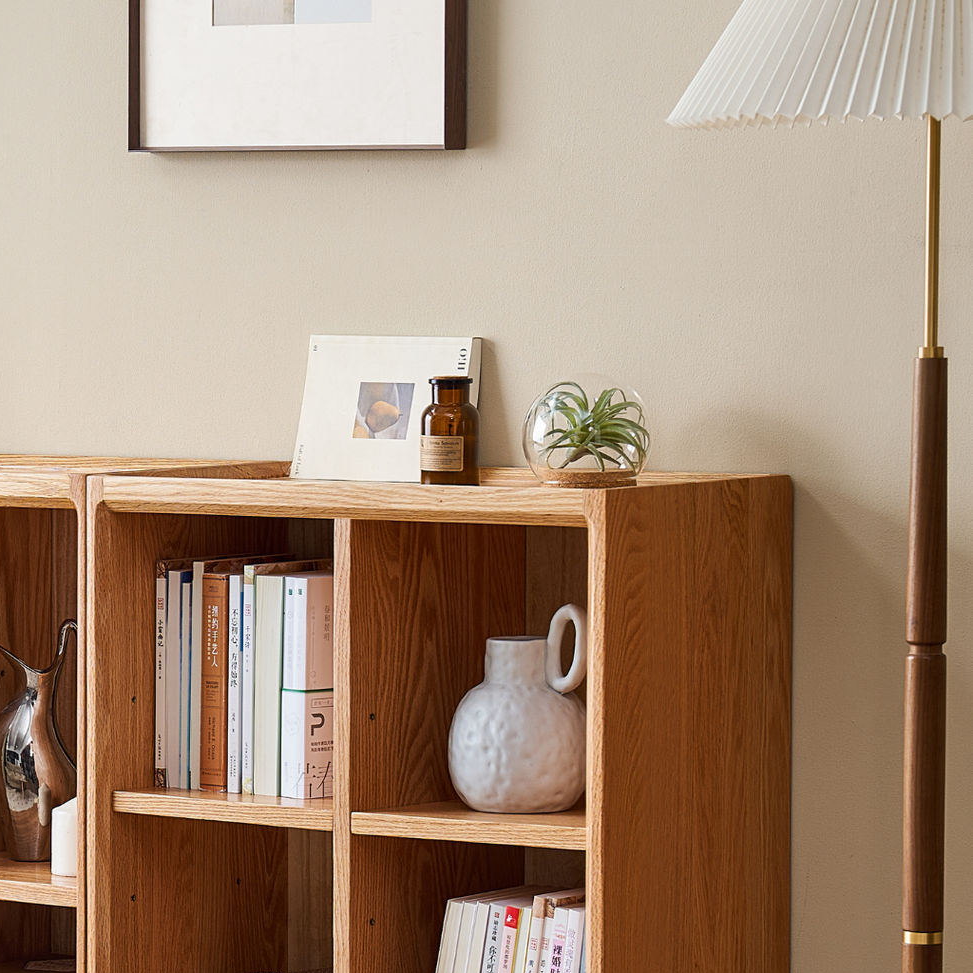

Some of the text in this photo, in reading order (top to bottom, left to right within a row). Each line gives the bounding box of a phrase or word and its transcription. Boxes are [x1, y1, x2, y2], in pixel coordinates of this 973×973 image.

[211, 605, 219, 667] 纽约手艺人
